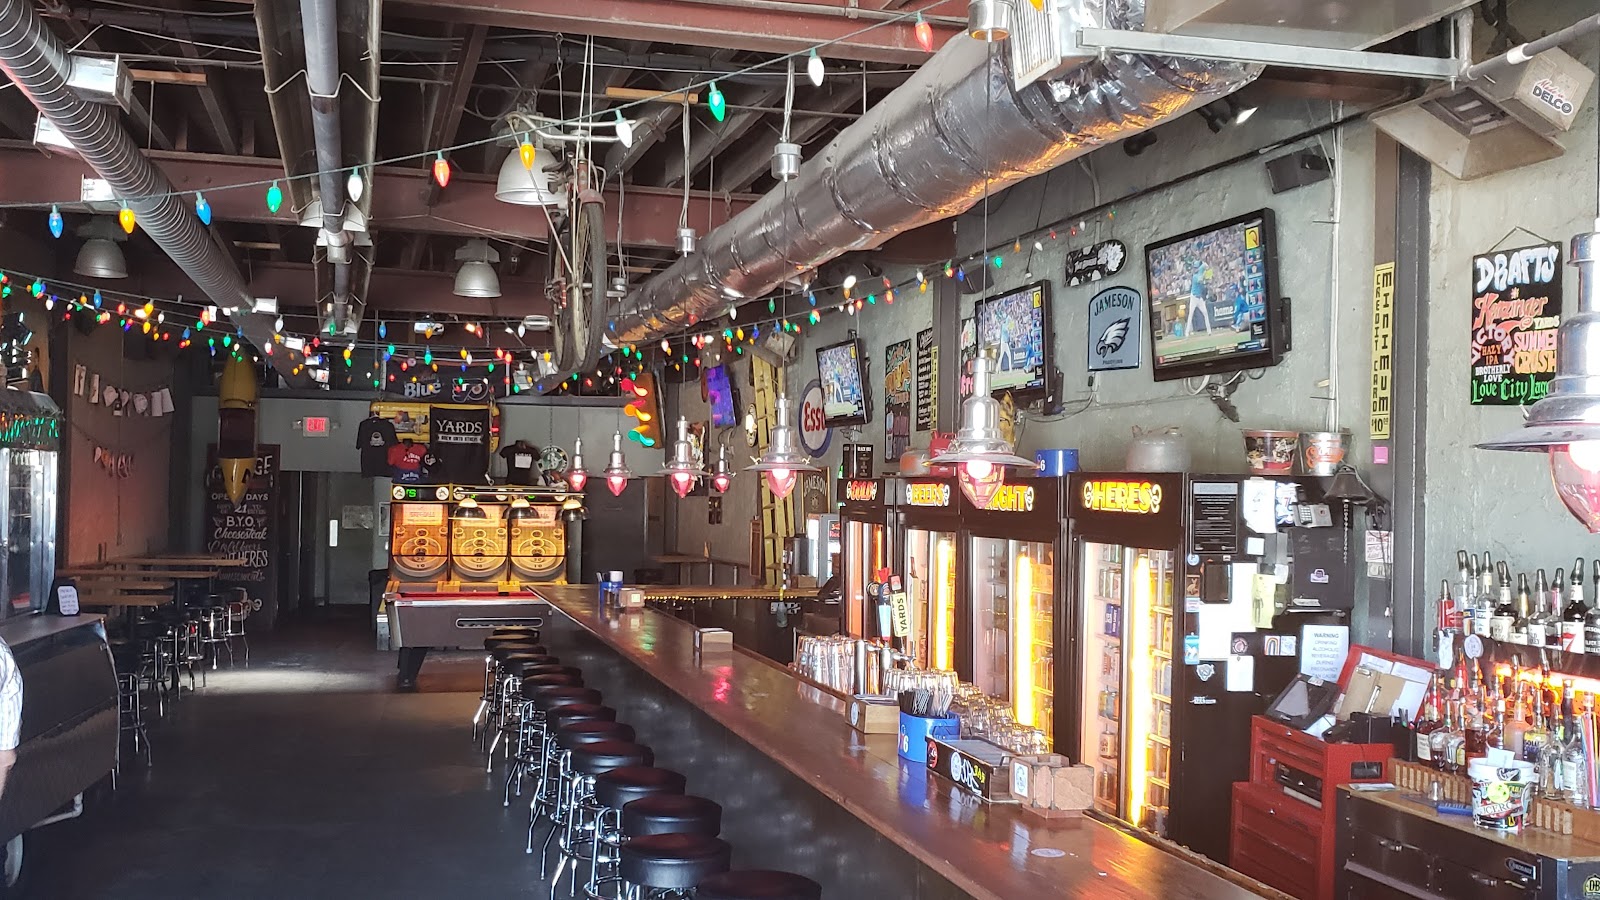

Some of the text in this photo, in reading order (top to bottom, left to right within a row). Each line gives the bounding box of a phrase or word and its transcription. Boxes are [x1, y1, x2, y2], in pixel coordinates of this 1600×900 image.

[1532, 85, 1573, 114] DELCO
[1476, 246, 1559, 294] DRAFTS
[1094, 293, 1135, 317] JAMESON
[1471, 323, 1516, 367] VICTORY
[1482, 344, 1502, 356] HAZY
[1475, 364, 1512, 376] BROTHERLY
[1485, 355, 1499, 366] IPA
[1484, 374, 1503, 383] LOVE
[404, 379, 442, 399] Blue
[1472, 379, 1498, 404] Love
[1500, 378, 1528, 405] City
[436, 420, 483, 434] YARDS
[246, 493, 269, 501] DAYS
[911, 483, 944, 506] BEERS
[1092, 481, 1152, 513] HERES
[226, 516, 255, 527] B.Y.O.
[214, 527, 267, 540] Cheesesteak
[897, 597, 907, 632] YARDS
